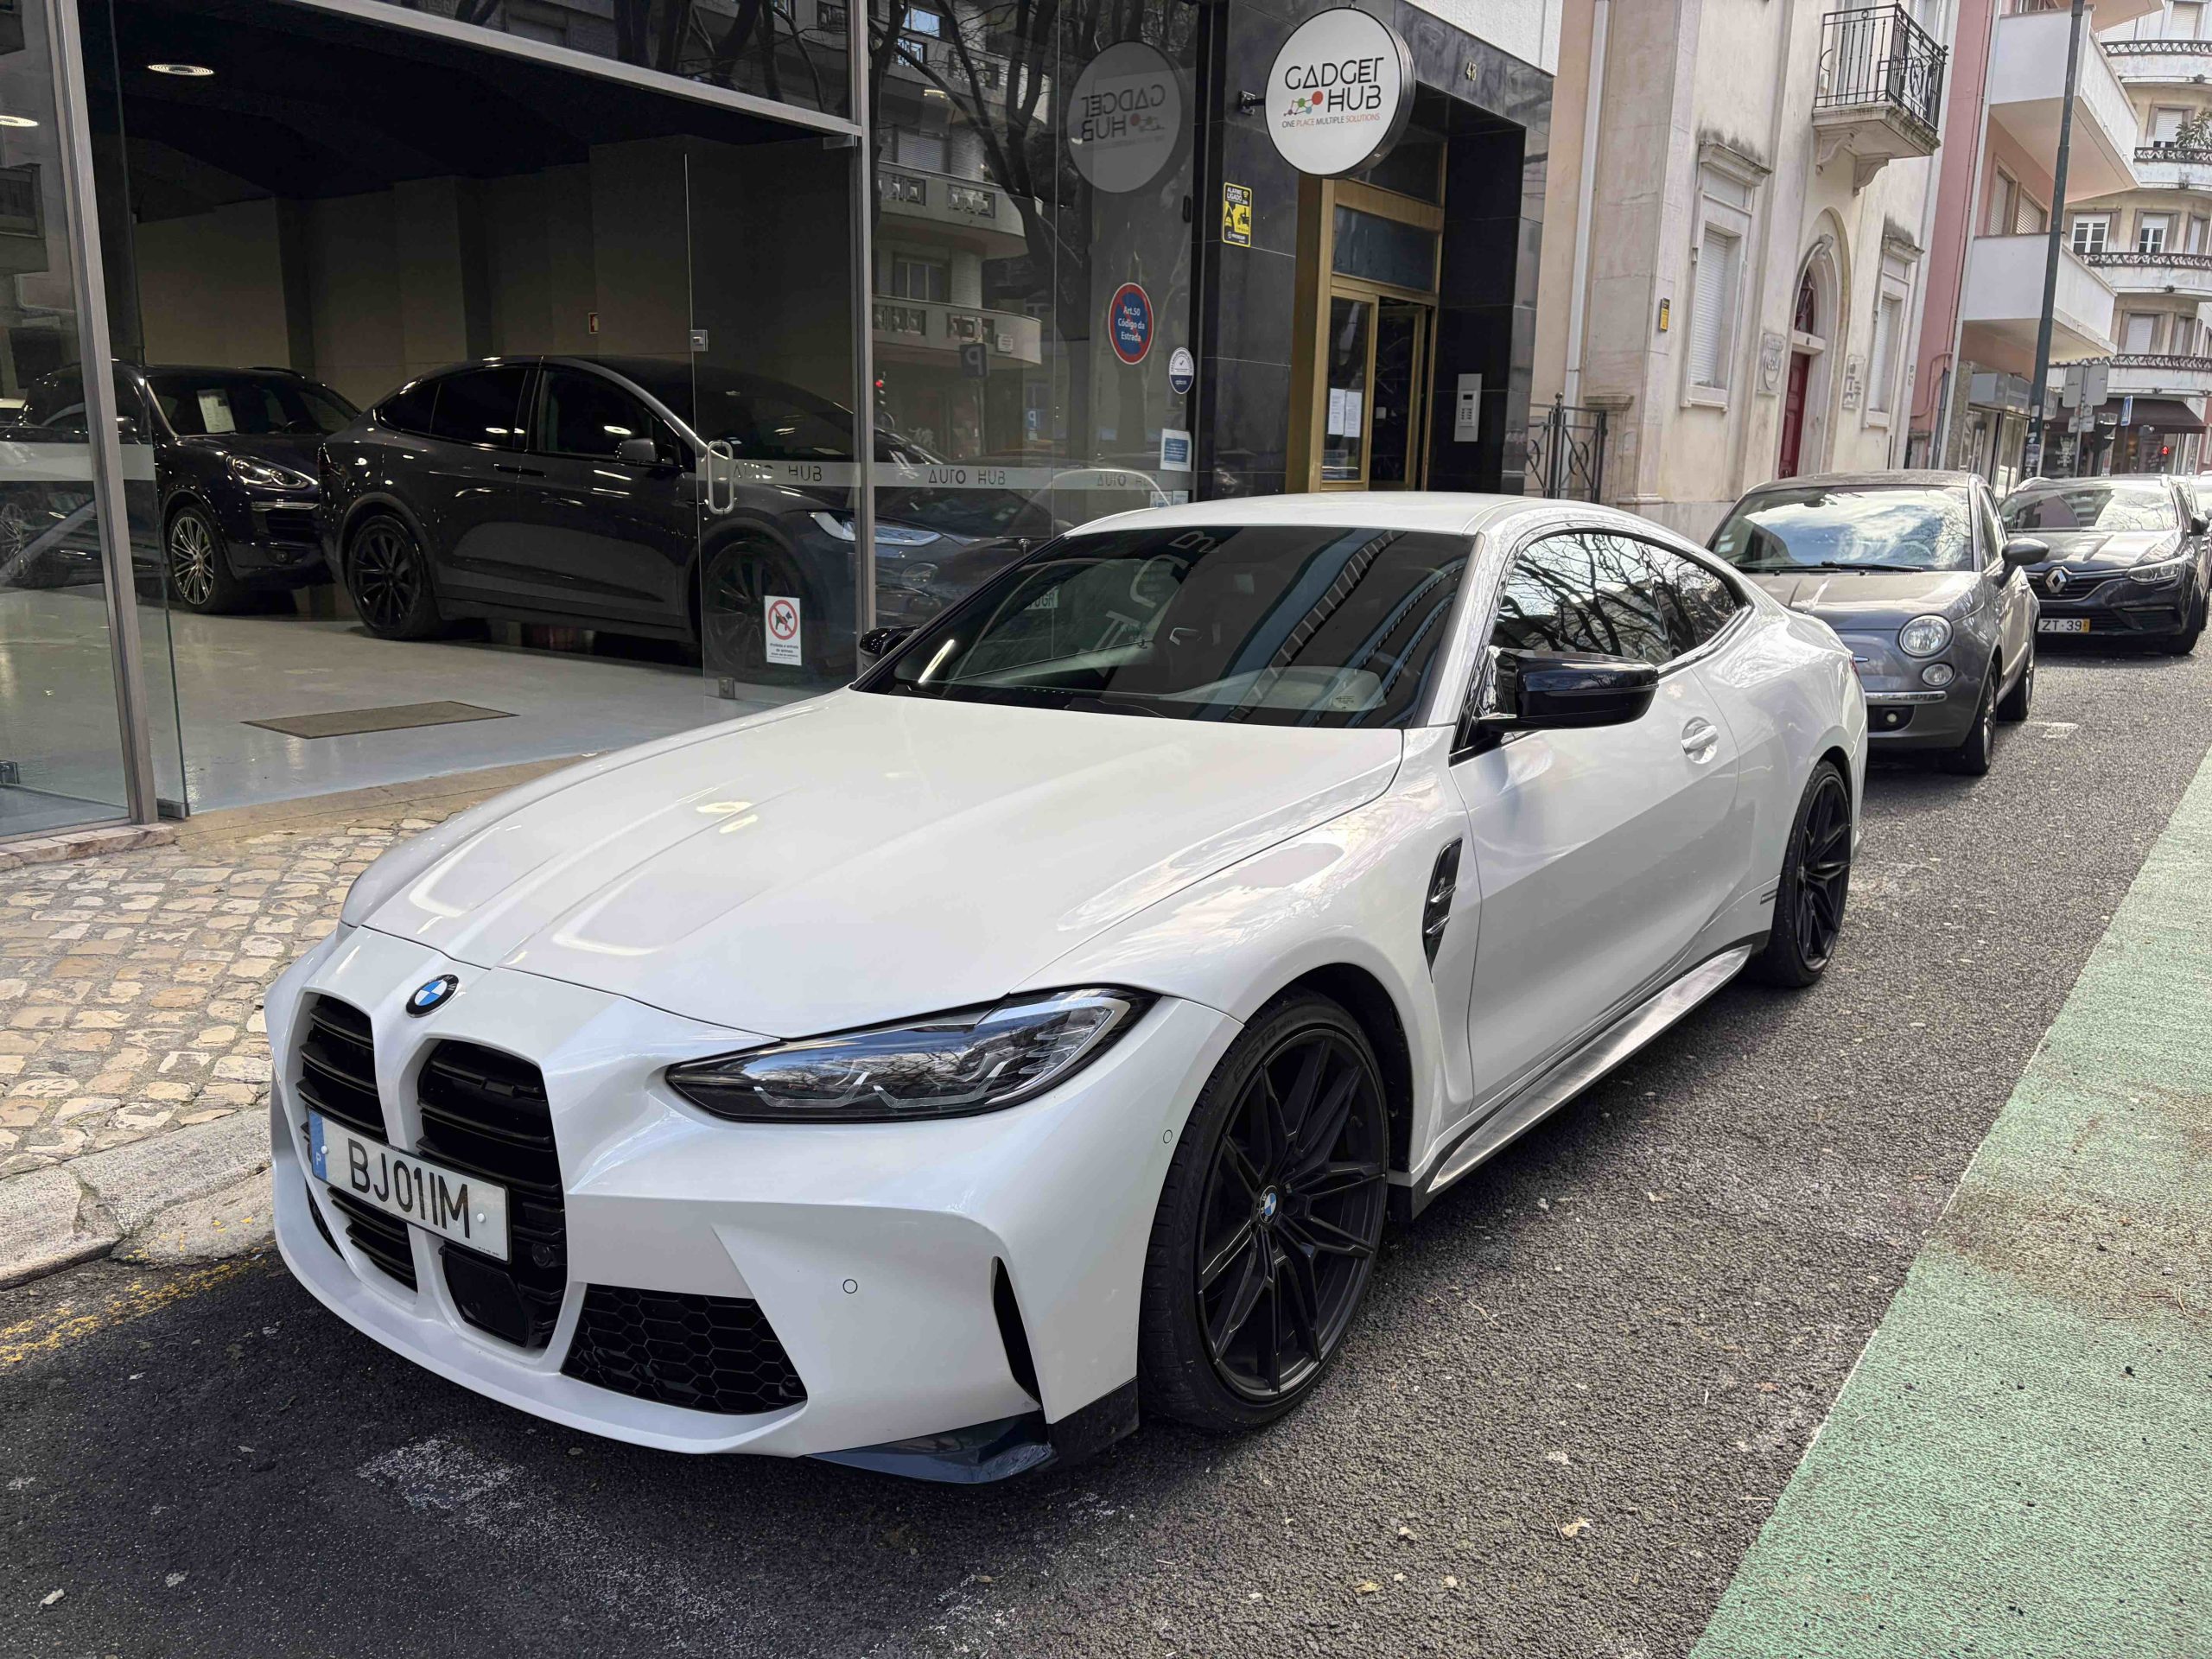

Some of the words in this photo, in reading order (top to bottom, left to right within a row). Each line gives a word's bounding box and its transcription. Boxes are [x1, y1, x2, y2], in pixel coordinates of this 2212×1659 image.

[1285, 57, 1384, 90] GADGET
[1466, 61, 1477, 81] 48
[1327, 85, 1382, 113] HUB
[1296, 118, 1315, 127] PLACE
[1316, 116, 1344, 125] MULTIPLE
[1345, 113, 1381, 124] SOLUTIONS
[1118, 318, 1138, 330] Código
[1137, 321, 1146, 330] da
[1121, 331, 1141, 342] Estrada
[788, 465, 823, 482] HUB
[928, 468, 967, 484] AUTO
[977, 469, 1006, 485] HUB
